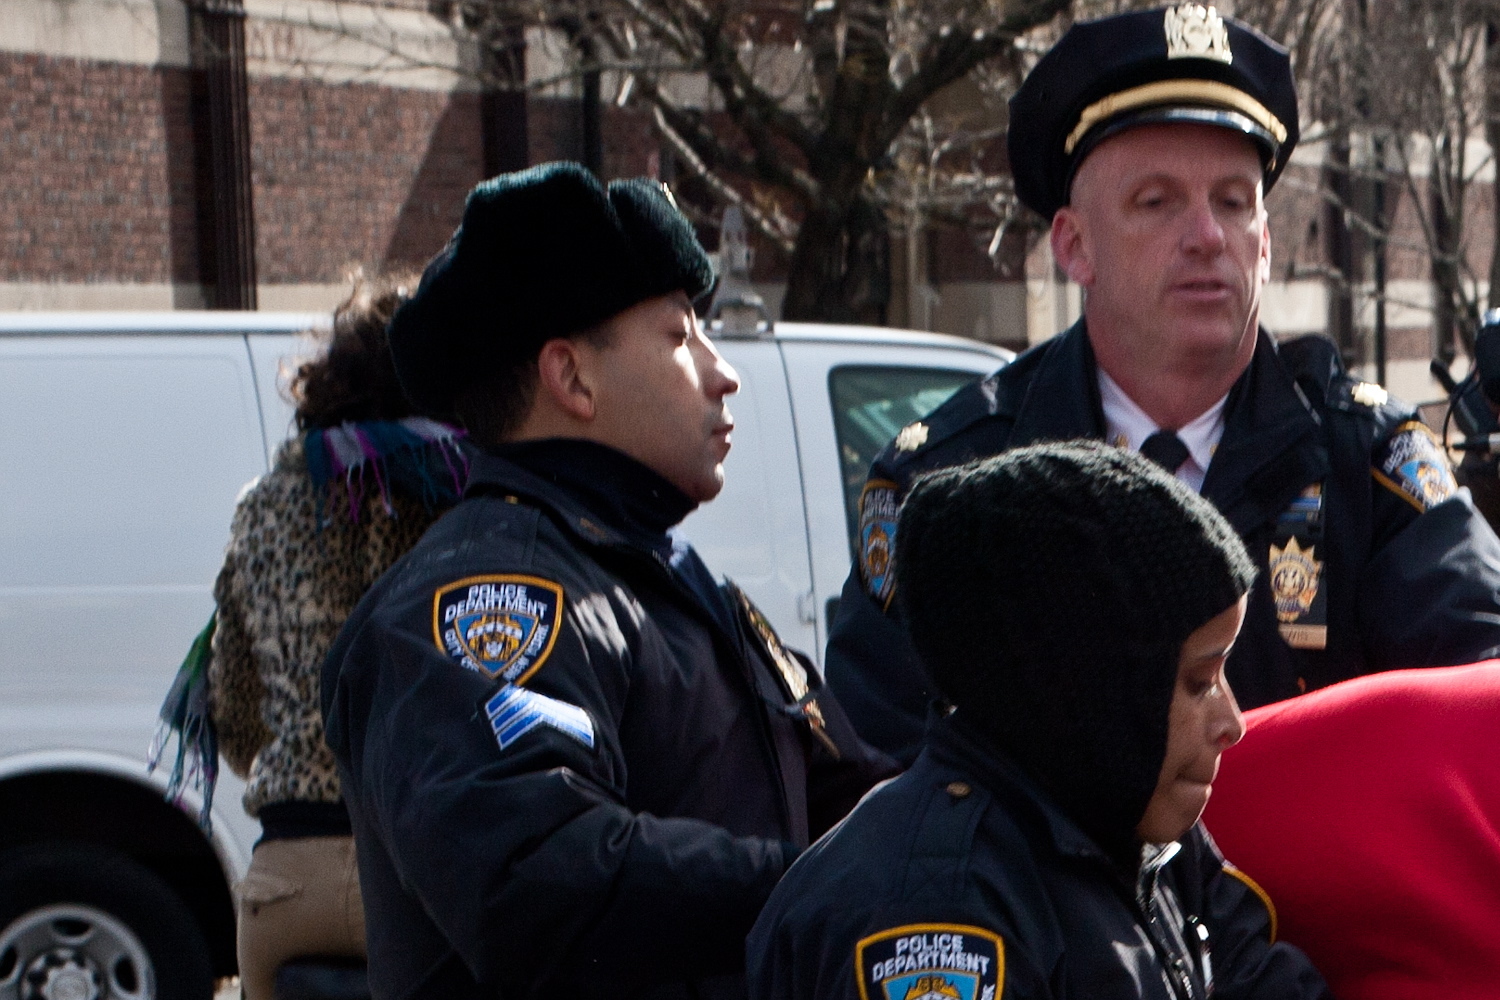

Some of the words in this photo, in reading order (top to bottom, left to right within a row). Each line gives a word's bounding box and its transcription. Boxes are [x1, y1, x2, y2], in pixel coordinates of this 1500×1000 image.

[467, 583, 528, 602] POLICE
[444, 596, 548, 623] DEPARTMENT
[895, 934, 963, 955] POLICE
[872, 950, 990, 983] DEPARTMENT
